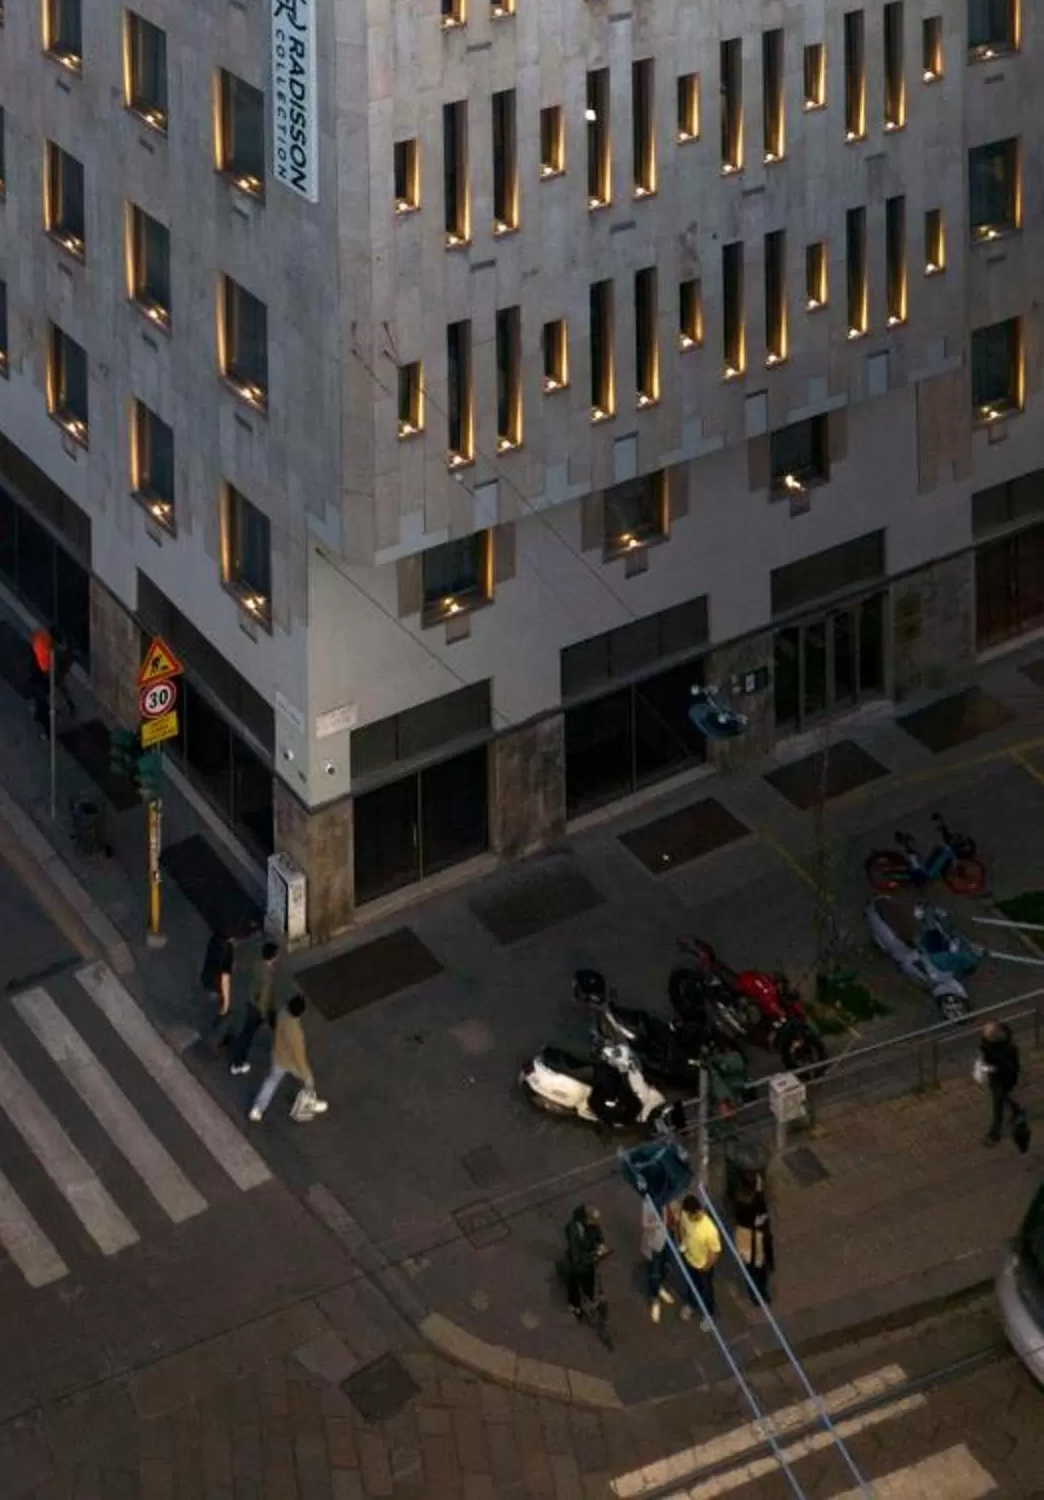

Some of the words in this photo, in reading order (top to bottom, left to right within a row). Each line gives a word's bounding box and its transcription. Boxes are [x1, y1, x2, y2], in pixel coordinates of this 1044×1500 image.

[275, 28, 288, 179] COLLECTION
[288, 34, 308, 193] RADISSON
[149, 688, 169, 709] 30
